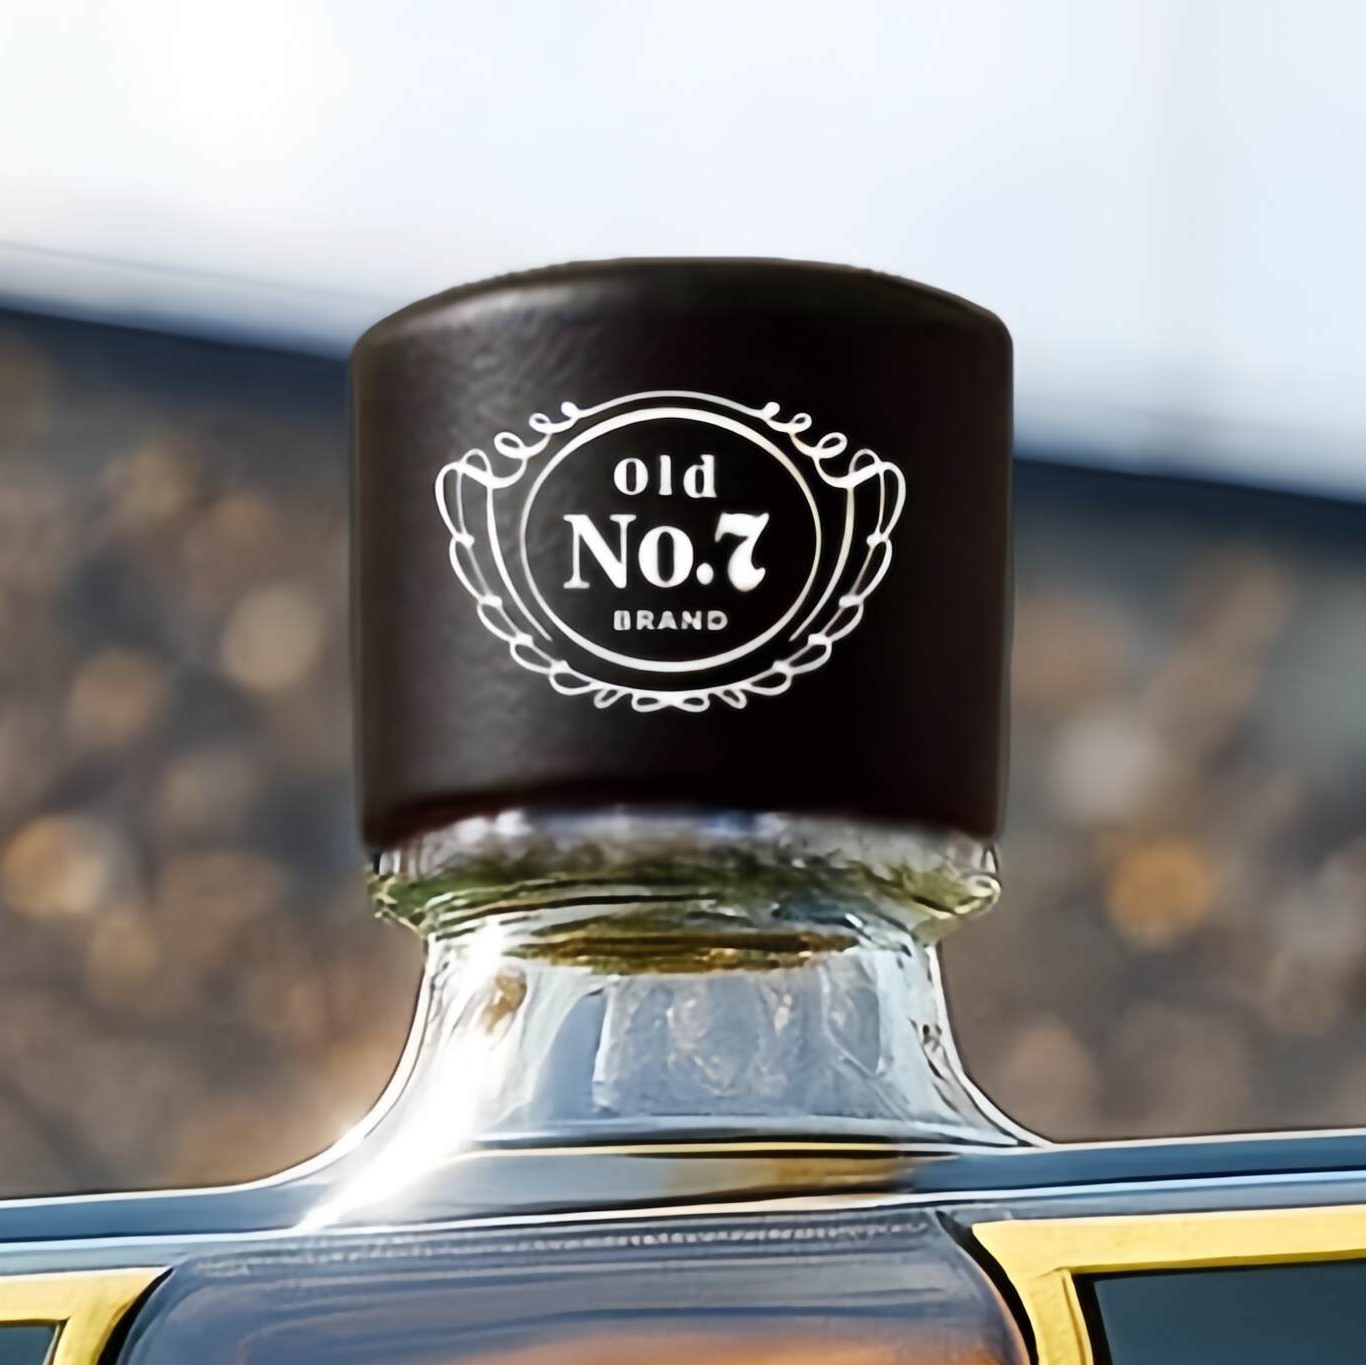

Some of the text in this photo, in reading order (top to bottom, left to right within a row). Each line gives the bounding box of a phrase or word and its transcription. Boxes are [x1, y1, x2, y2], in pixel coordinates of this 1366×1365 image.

[613, 454, 717, 499] old
[562, 512, 770, 592] No.7
[612, 609, 729, 631] BRAND
